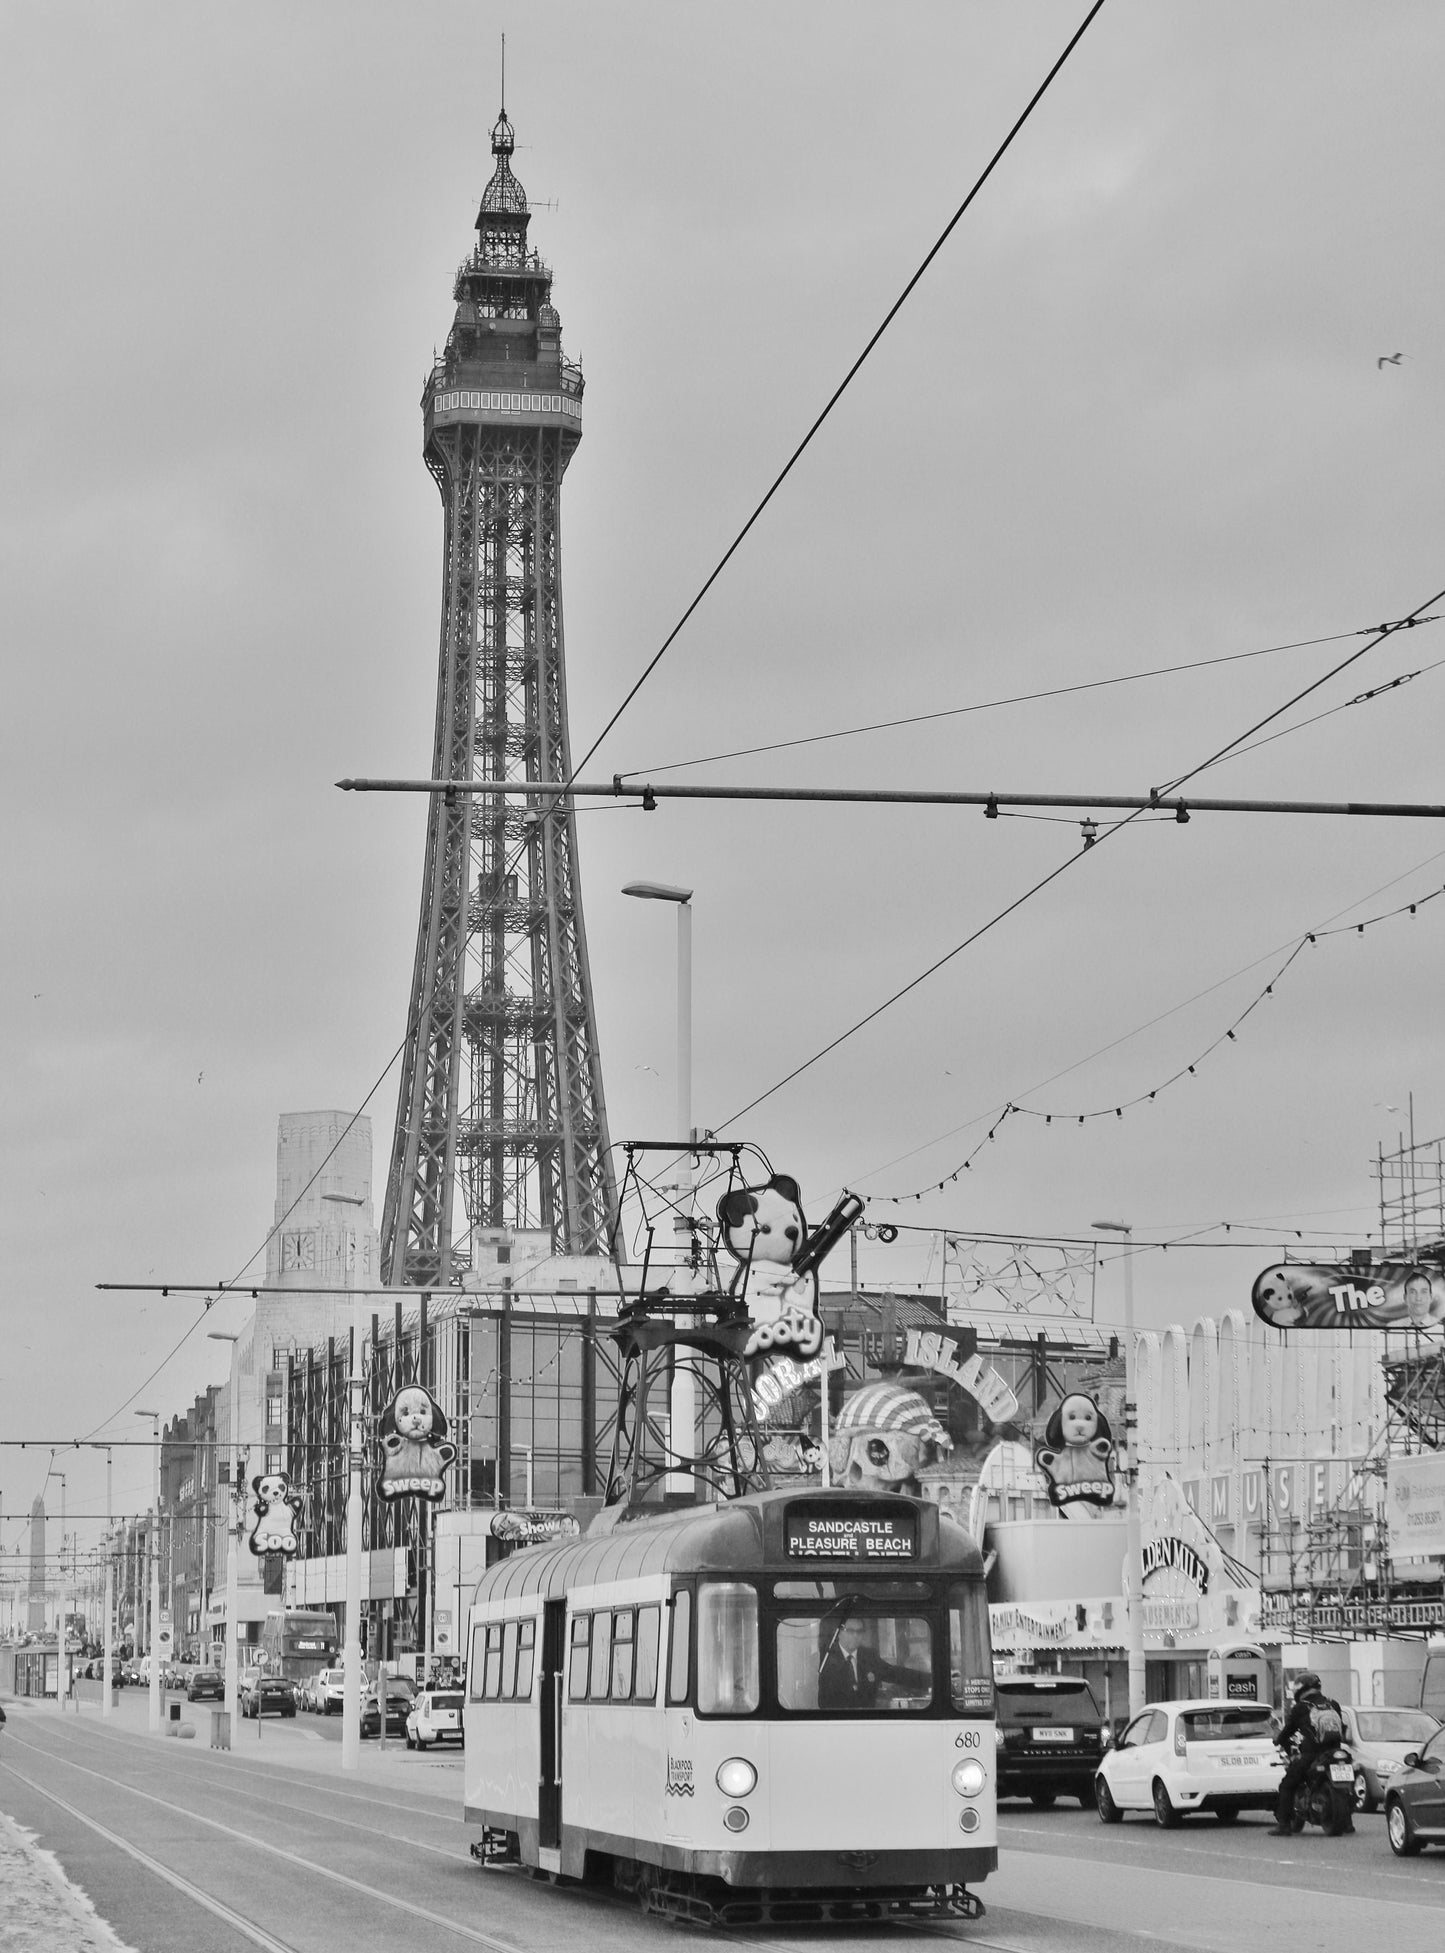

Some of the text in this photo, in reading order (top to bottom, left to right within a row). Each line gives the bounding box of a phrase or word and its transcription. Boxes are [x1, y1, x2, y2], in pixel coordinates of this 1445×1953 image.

[1328, 1283, 1386, 1313] The
[904, 1328, 1018, 1424] ISLAND
[382, 1478, 443, 1496] Sweep
[1055, 1482, 1113, 1500] Sweep
[1186, 1461, 1364, 1517] AMUSEM
[519, 1521, 555, 1536] Show
[808, 1521, 893, 1534] SANDCASTLE
[254, 1532, 297, 1552] Soo
[790, 1537, 911, 1550] PLEASURE BEACH
[1141, 1537, 1209, 1595] LDEN MILE
[992, 1608, 1067, 1641] FAMILY ENTERTAINMENT
[1141, 1605, 1191, 1626] USEMENTS
[1228, 1681, 1256, 1693] cash
[954, 1731, 981, 1748] 680
